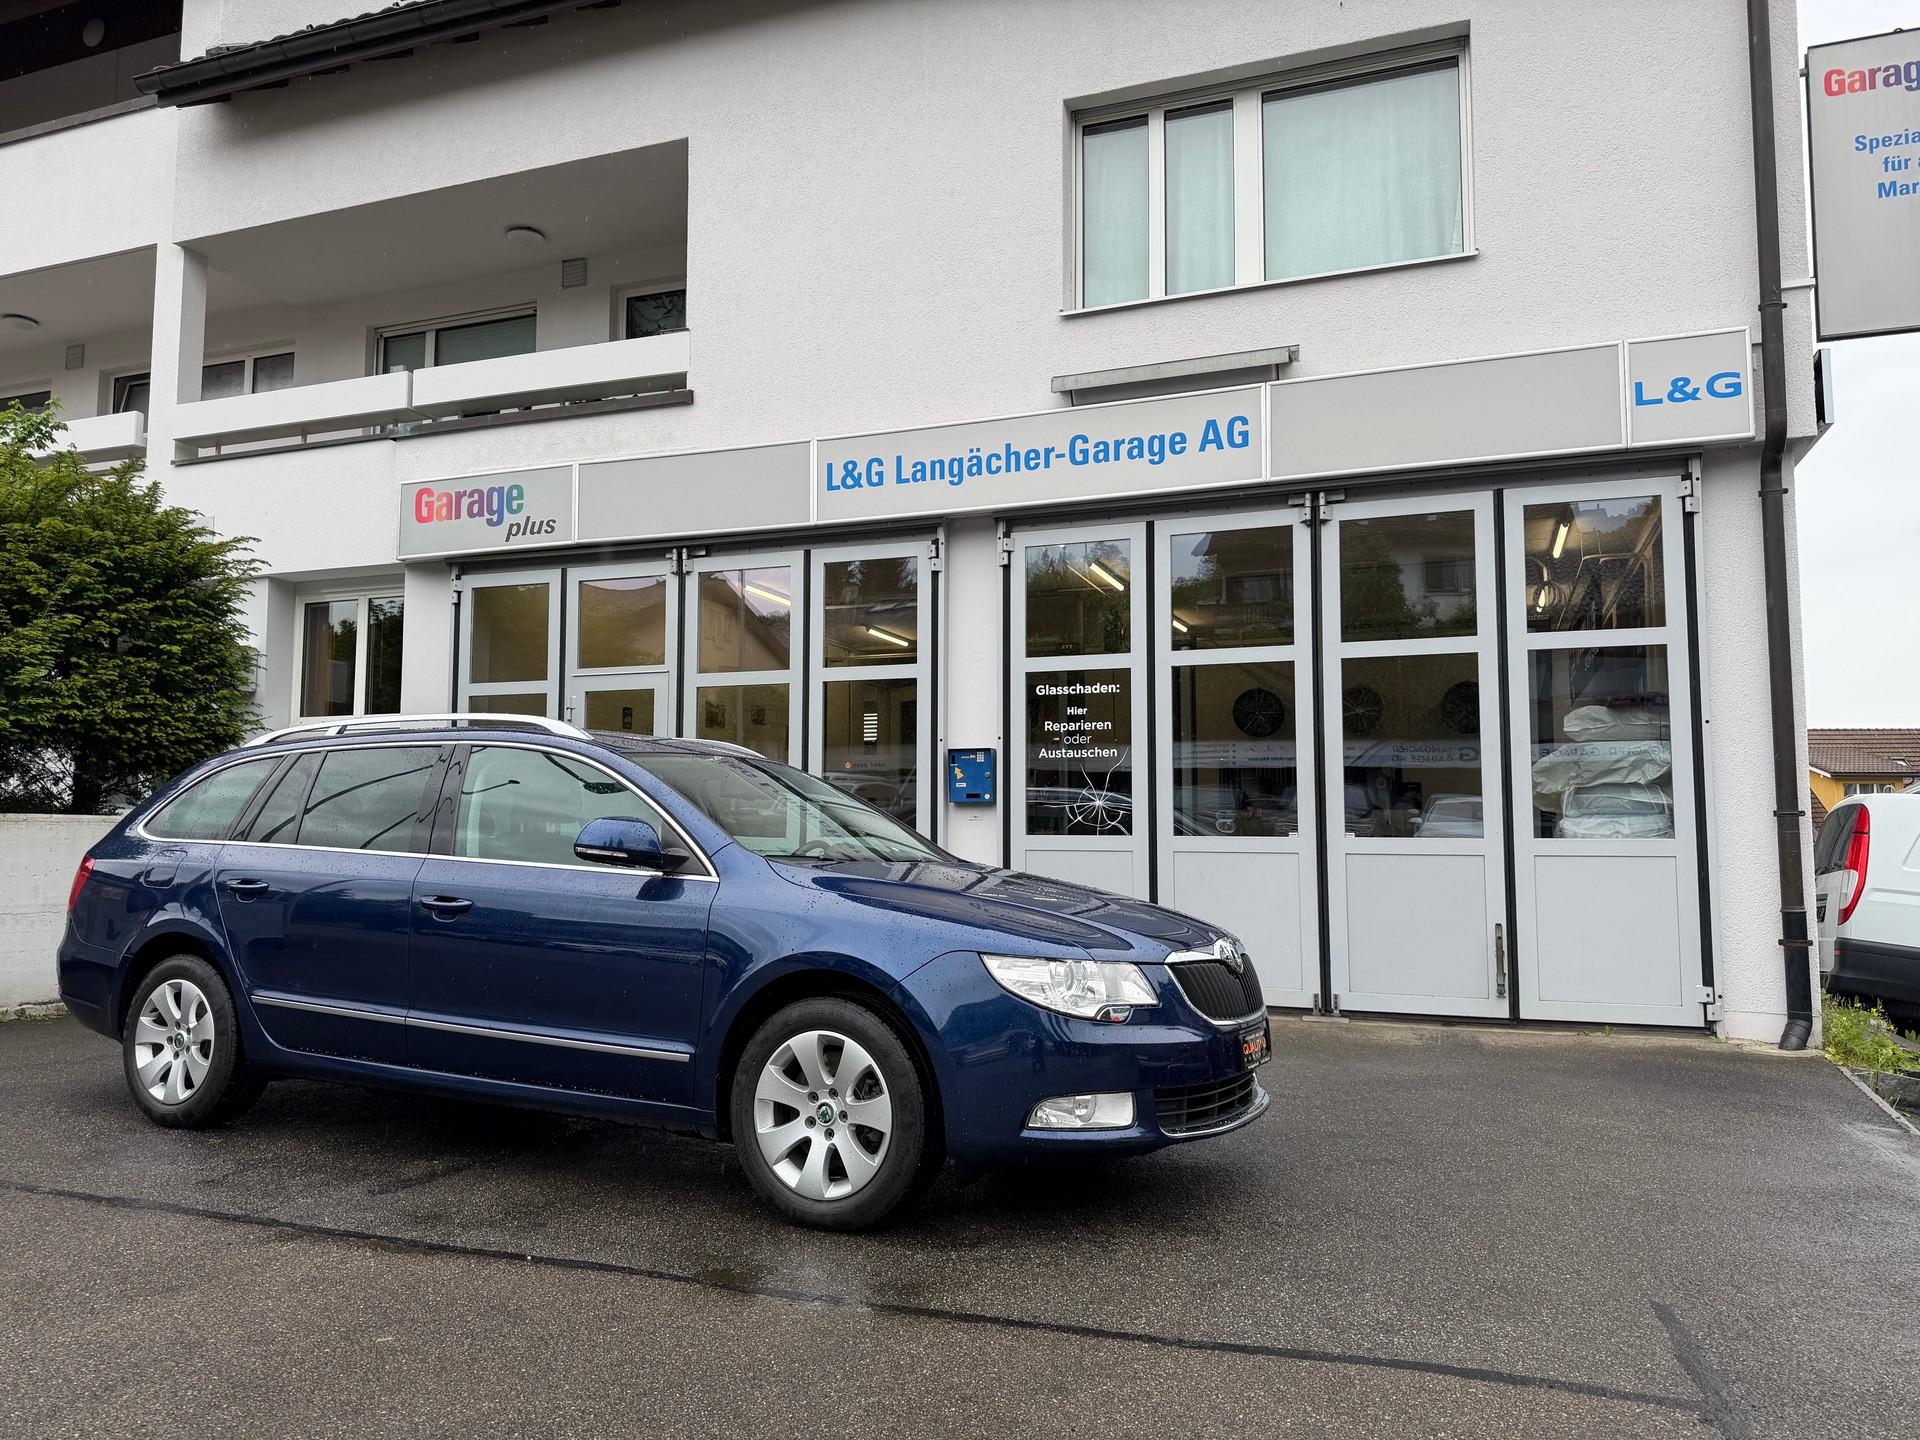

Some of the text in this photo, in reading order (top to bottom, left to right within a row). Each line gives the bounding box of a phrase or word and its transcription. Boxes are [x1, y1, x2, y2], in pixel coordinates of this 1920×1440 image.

[1882, 156, 1911, 173] für
[1634, 371, 1743, 406] L&G
[826, 415, 1250, 492] L&G Langächer-Garage AG
[414, 483, 525, 527] Garage
[505, 515, 557, 543] plus
[1035, 682, 1121, 696] Glasschaden:
[1066, 706, 1088, 716] Hier
[1044, 720, 1112, 733] Reparieren
[1063, 734, 1093, 745] oder
[1038, 746, 1118, 759] Austauschen
